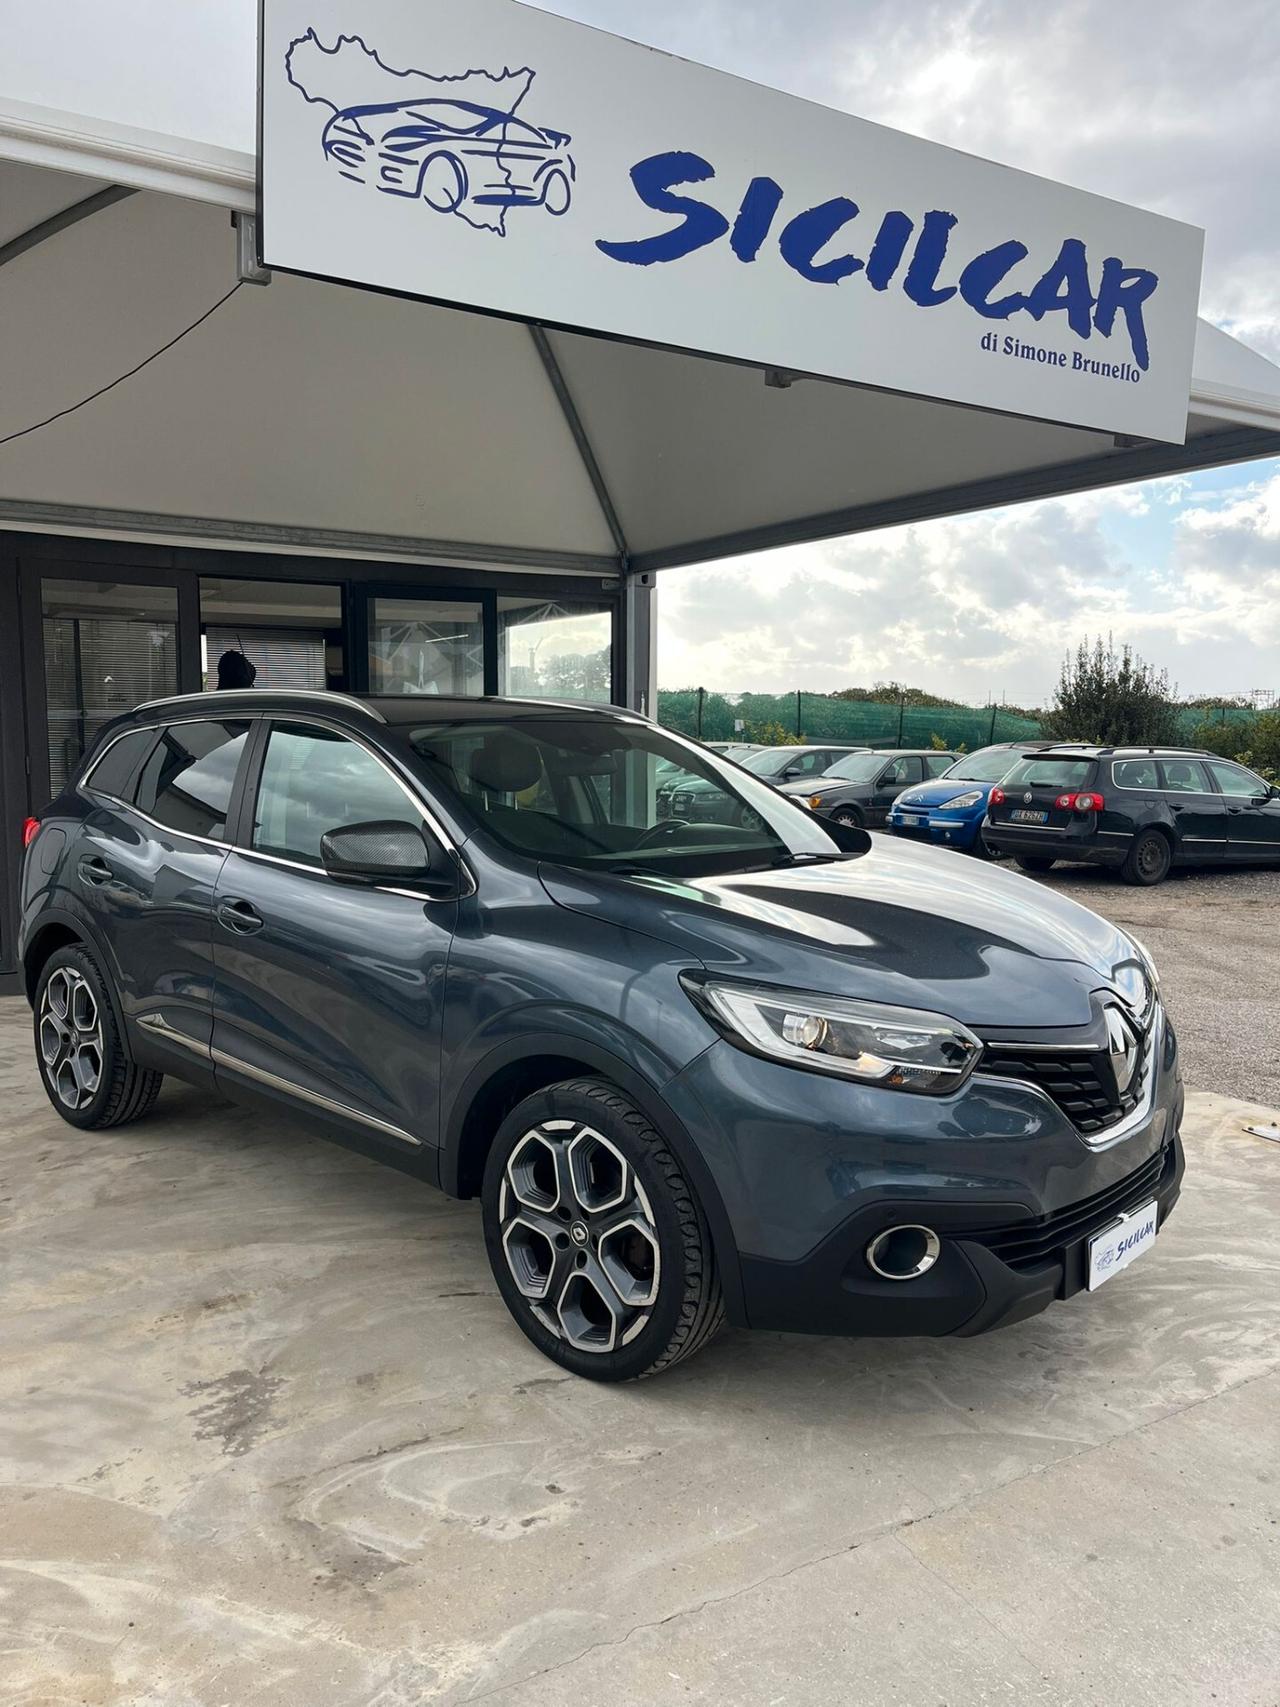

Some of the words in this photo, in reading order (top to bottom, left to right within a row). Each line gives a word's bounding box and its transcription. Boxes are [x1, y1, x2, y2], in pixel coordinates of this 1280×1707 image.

[595, 151, 1158, 371] SICILCAR
[981, 332, 998, 352] di
[1003, 335, 1067, 367] Simone
[1072, 351, 1140, 383] Brunello
